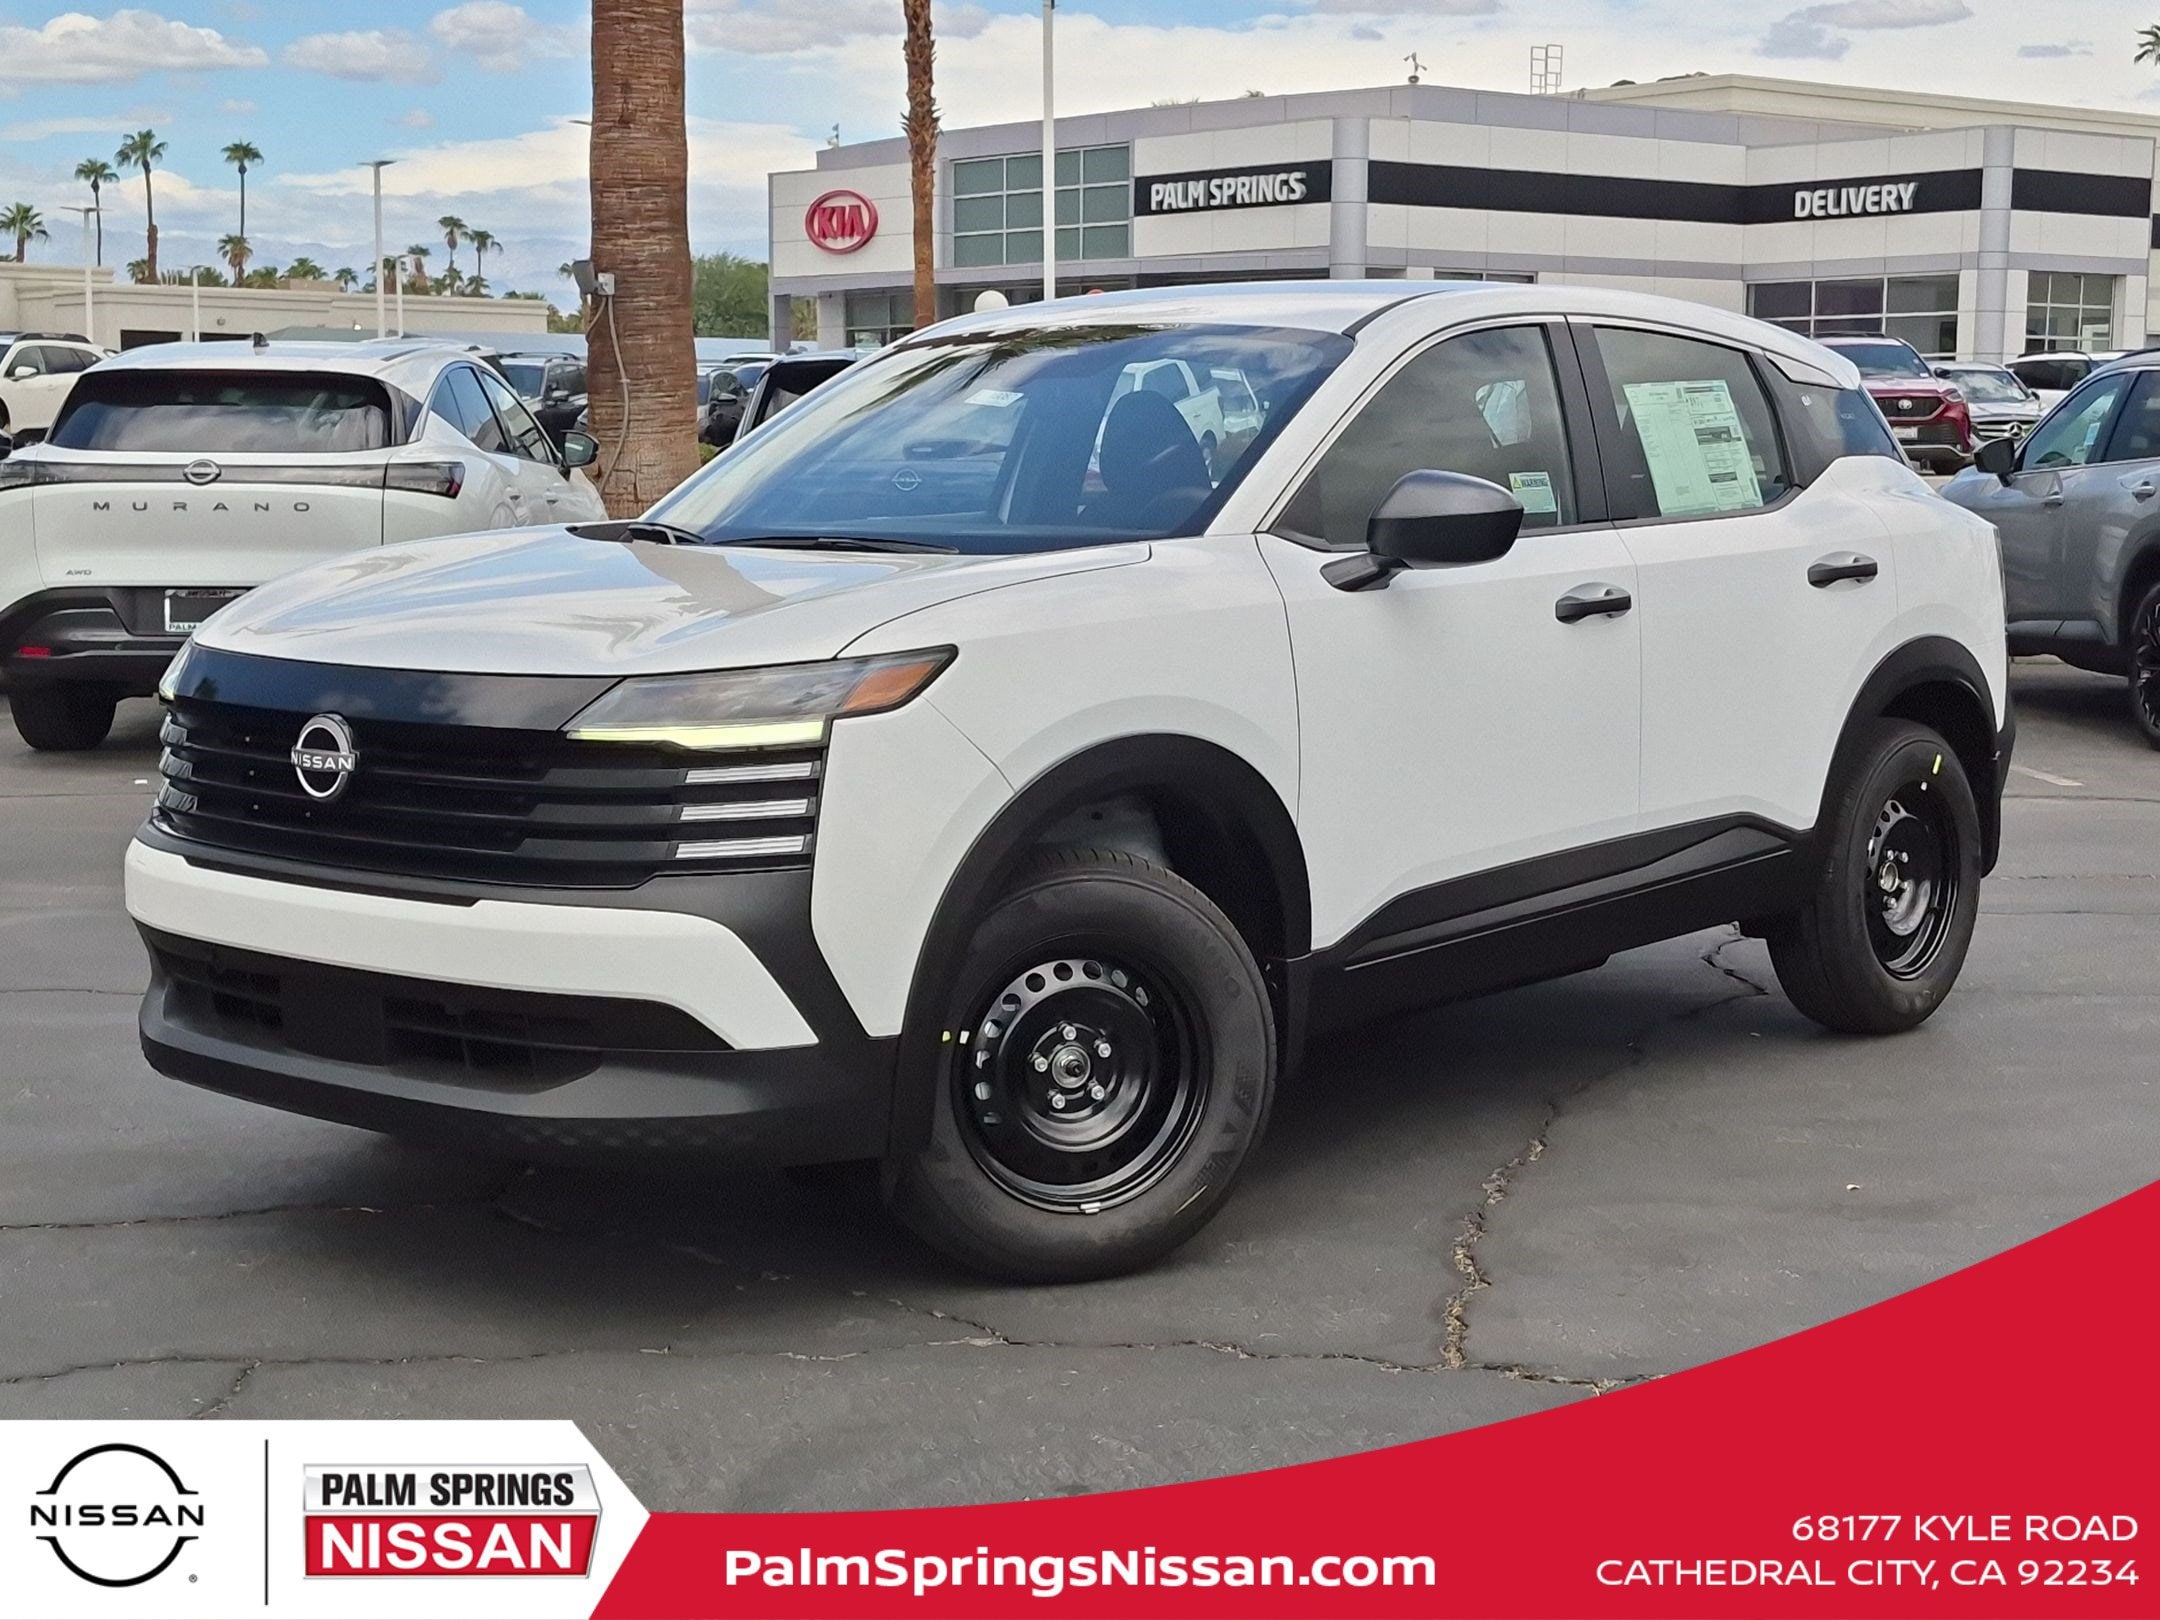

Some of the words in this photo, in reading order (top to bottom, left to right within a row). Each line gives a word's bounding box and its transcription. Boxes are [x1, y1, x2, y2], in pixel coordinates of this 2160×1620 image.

[1150, 180, 1208, 211] PALM
[1209, 171, 1307, 206] SPRINGS
[1794, 182, 1918, 218] DELIVERY
[816, 205, 866, 240] KIA
[93, 501, 311, 512] MURANO
[65, 569, 93, 577] AWD
[168, 623, 197, 631] PALM
[291, 749, 353, 770] NISSAN
